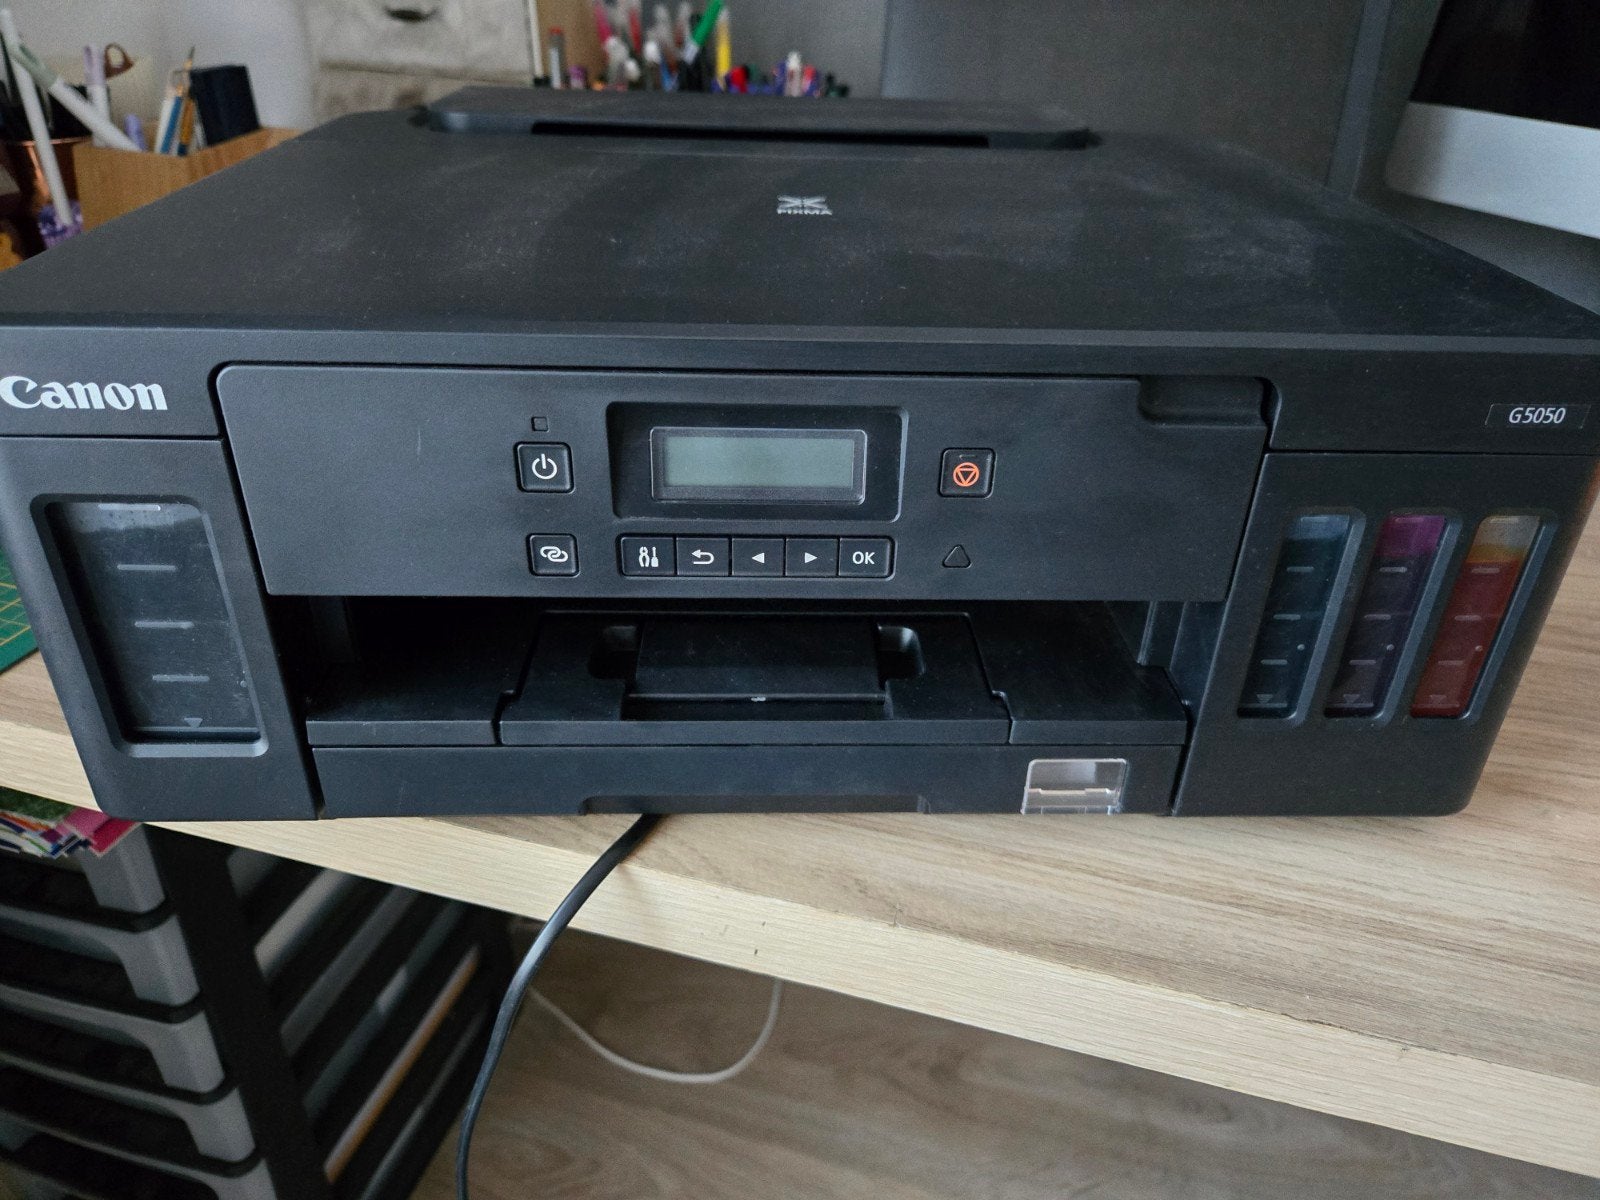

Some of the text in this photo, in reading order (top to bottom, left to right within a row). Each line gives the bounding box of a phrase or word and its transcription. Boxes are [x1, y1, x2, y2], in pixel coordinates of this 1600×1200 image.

[0, 375, 168, 411] Canon
[1508, 407, 1567, 424] G5050
[852, 551, 876, 565] OK
